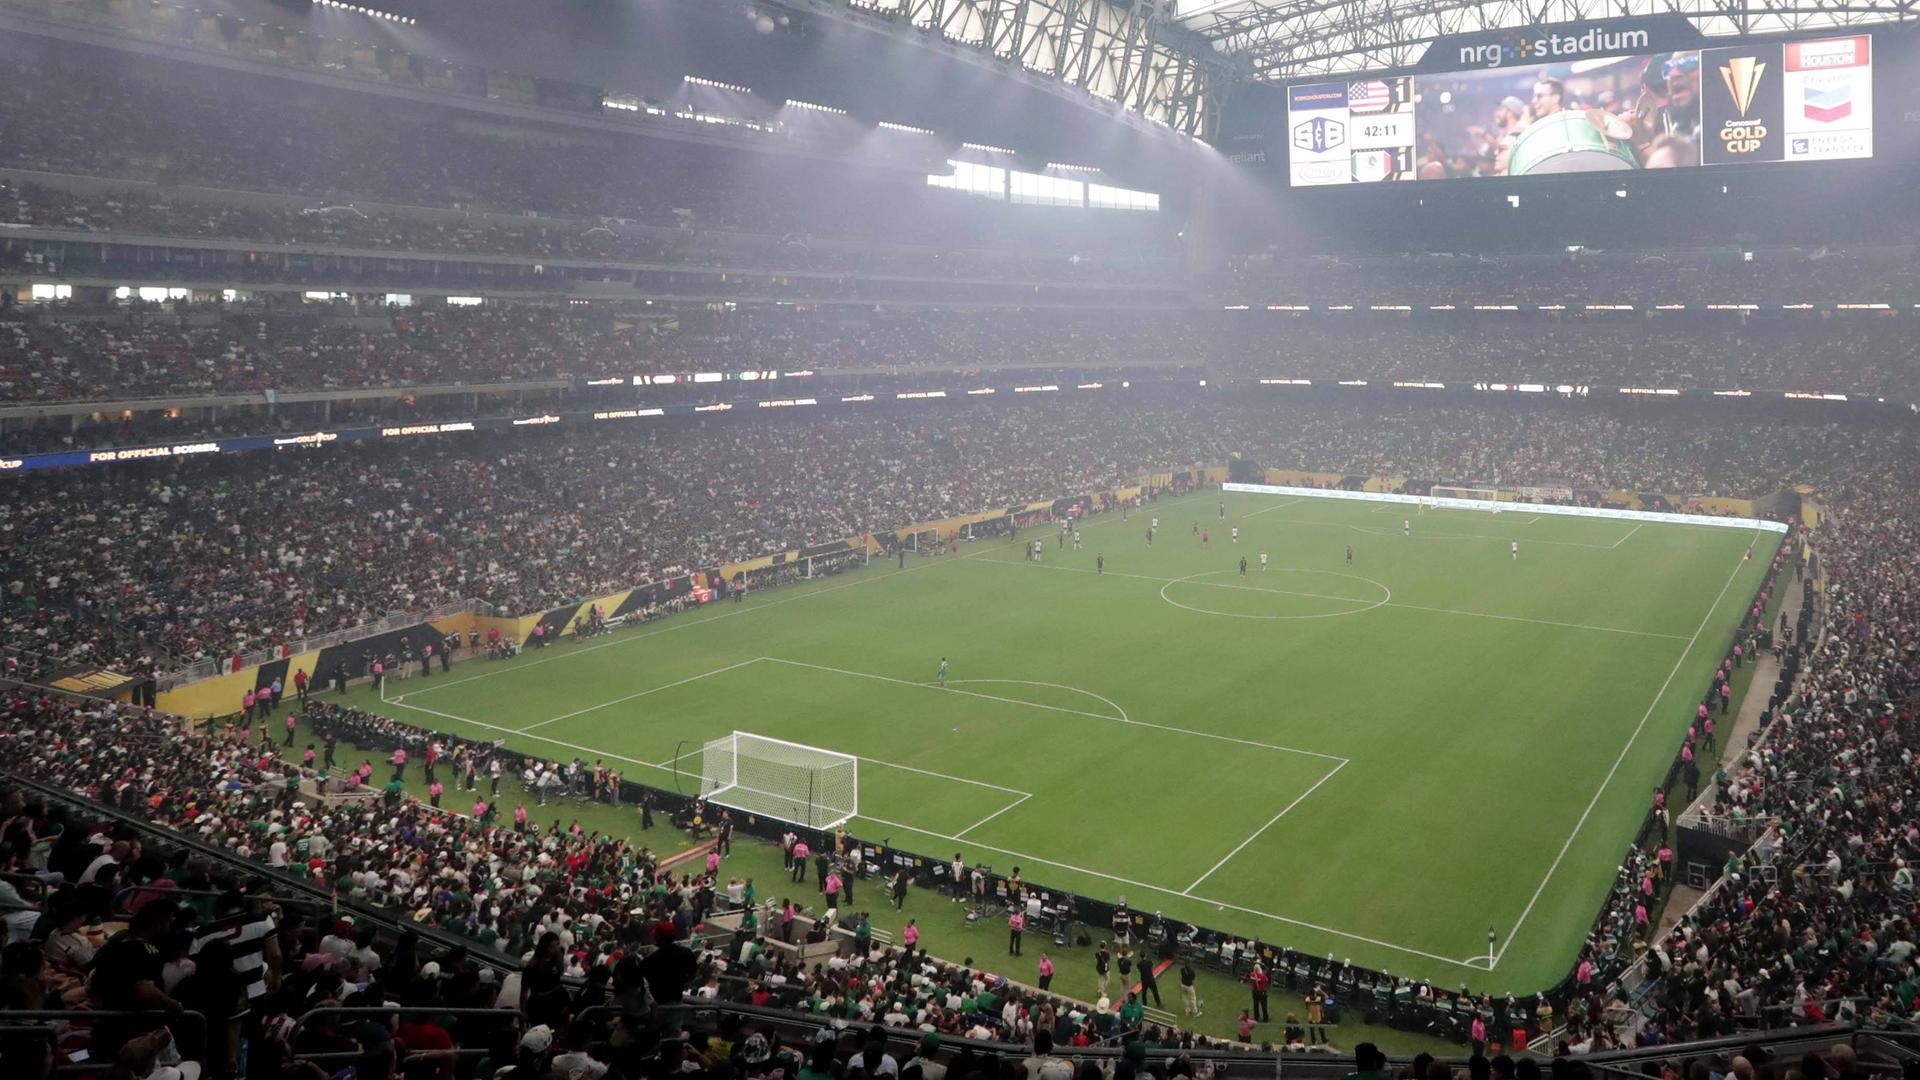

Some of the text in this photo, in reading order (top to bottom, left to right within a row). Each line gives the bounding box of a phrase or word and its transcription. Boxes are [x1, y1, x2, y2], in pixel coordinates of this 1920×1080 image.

[1460, 28, 1648, 67] nrg stadium
[1802, 52, 1854, 67] HOUSTON
[1396, 84, 1405, 102] 1
[1364, 124, 1397, 137] 42:11
[1720, 126, 1767, 140] GOLD
[1726, 139, 1761, 153] CUP
[1397, 154, 1406, 171] 1
[382, 428, 400, 436] FOR
[401, 425, 439, 434] OFFICIAL
[90, 452, 116, 462] FOR
[118, 447, 172, 459] OFFICIAL
